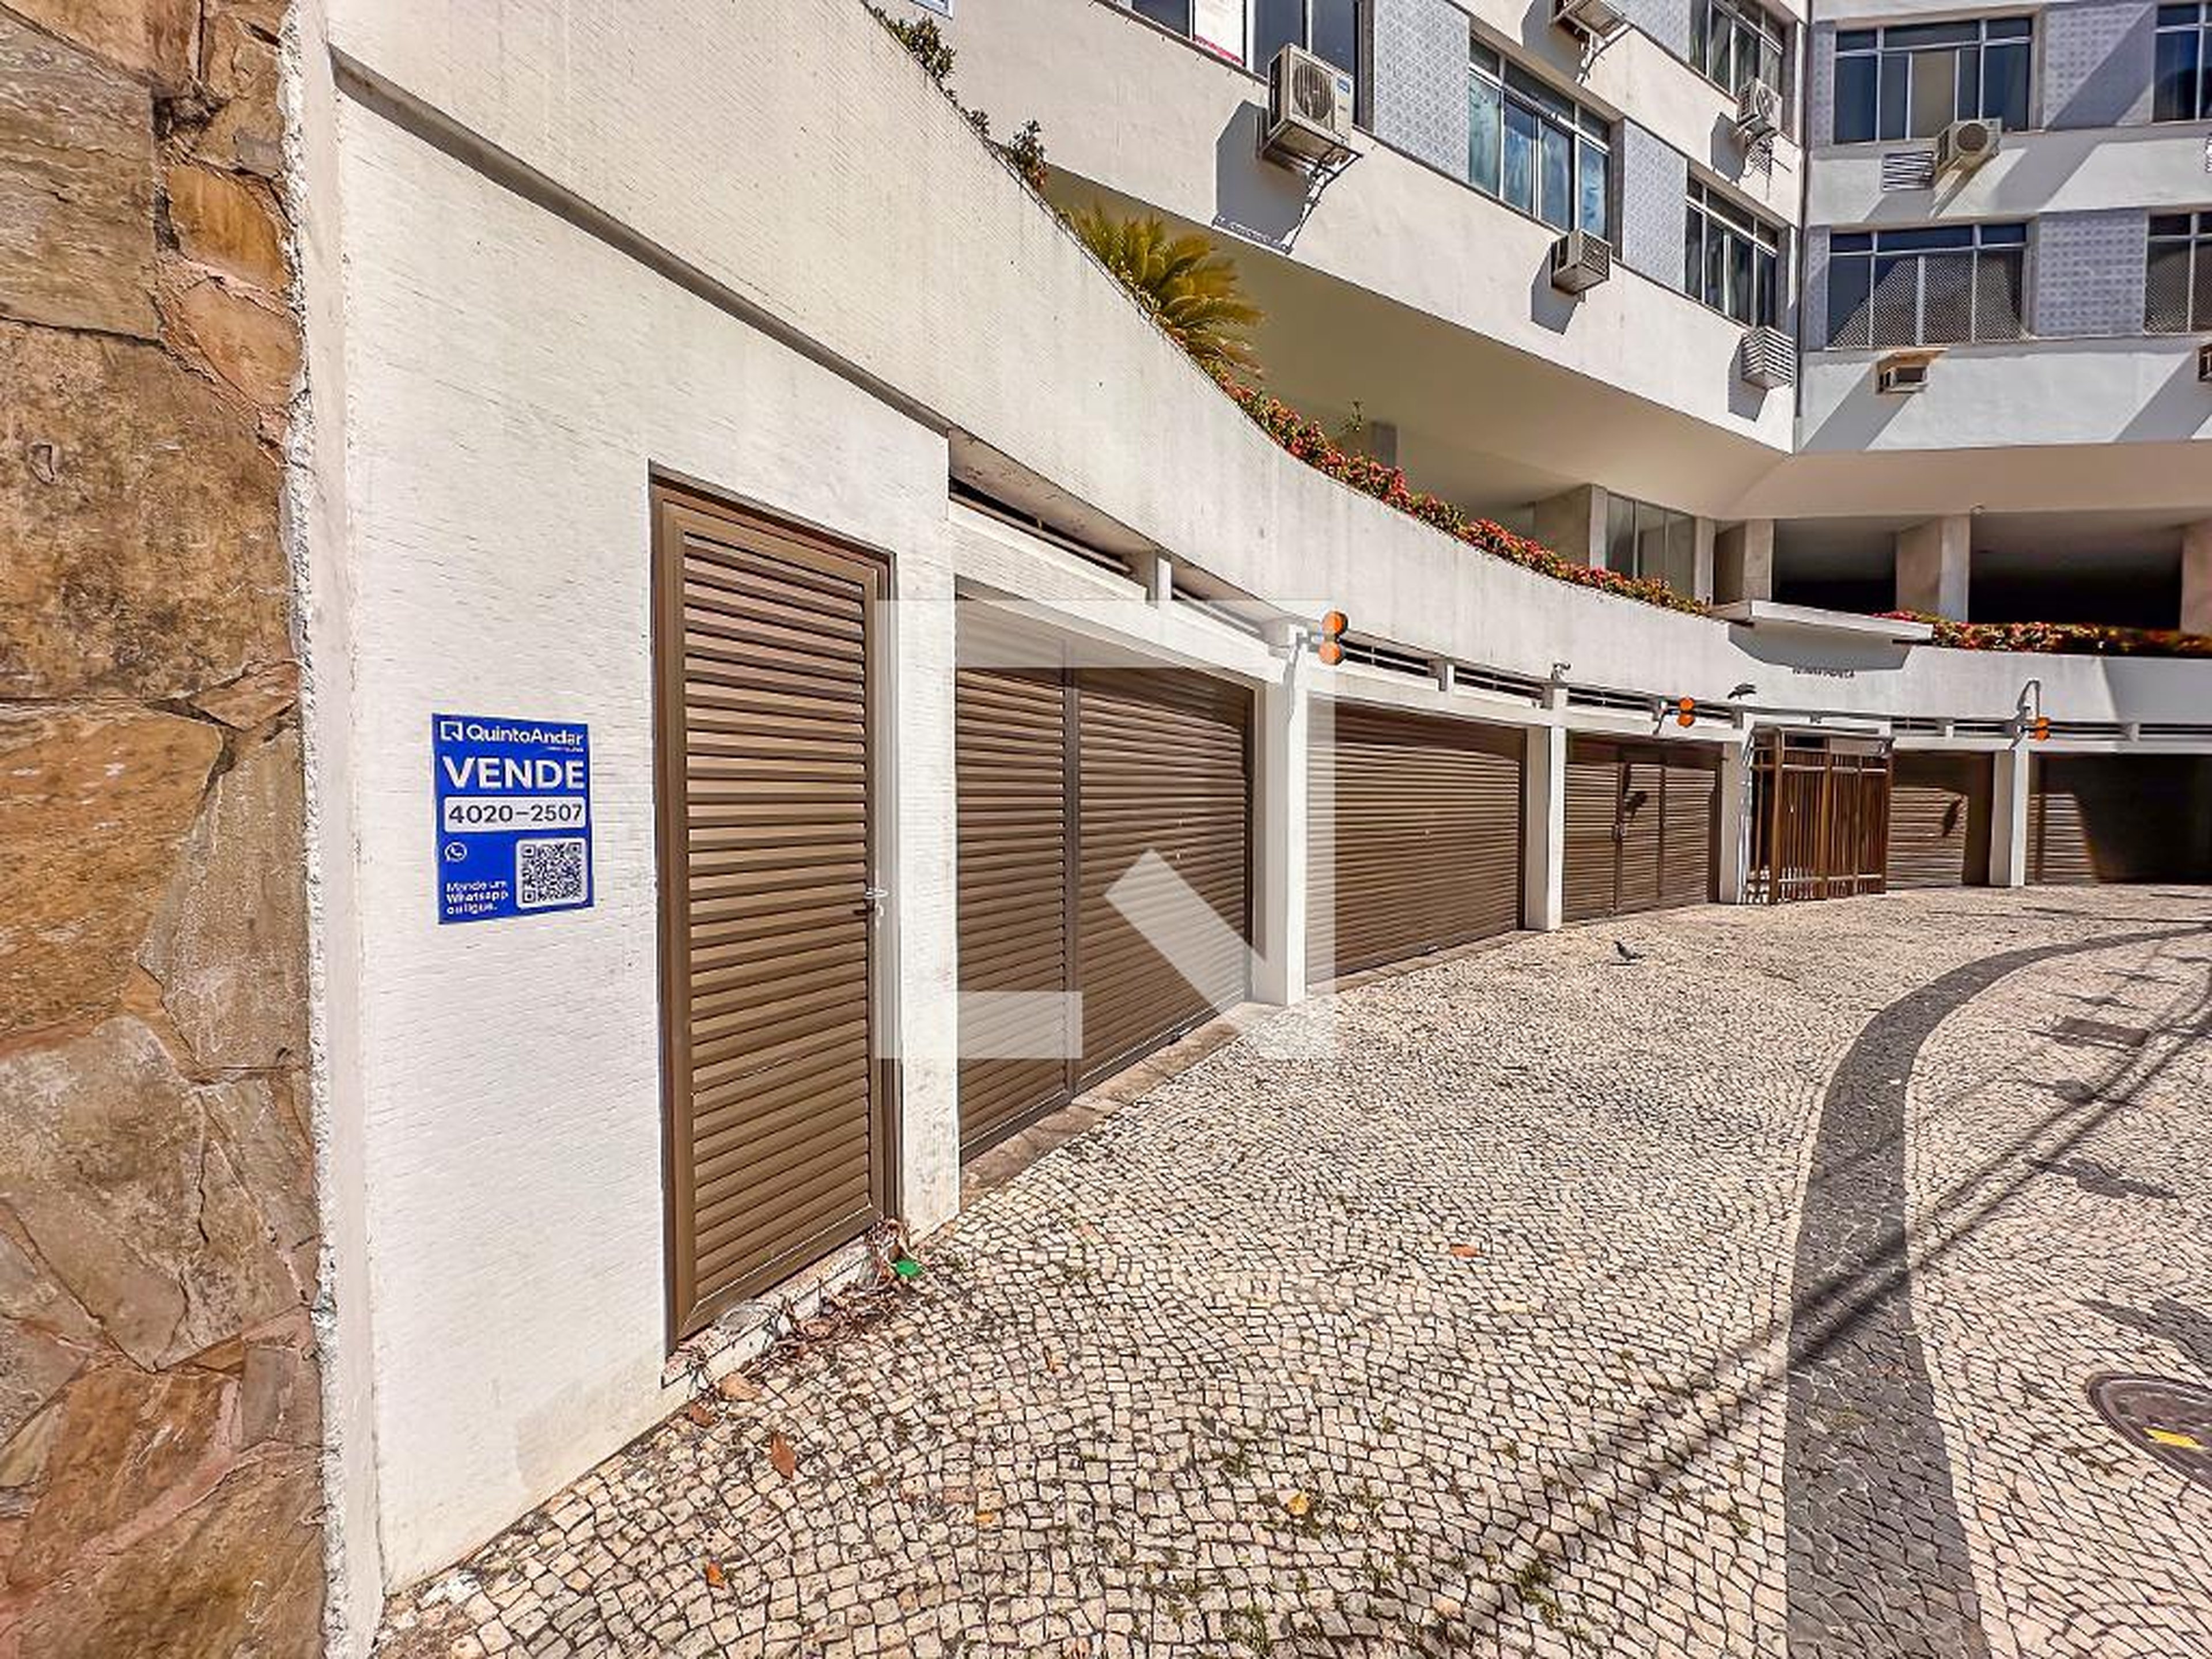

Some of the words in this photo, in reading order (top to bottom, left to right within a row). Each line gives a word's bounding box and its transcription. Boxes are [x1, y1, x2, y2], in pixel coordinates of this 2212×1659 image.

[465, 725, 584, 745] QuintoAndar
[442, 756, 585, 790] VENDE
[449, 804, 582, 824] 4020-2507
